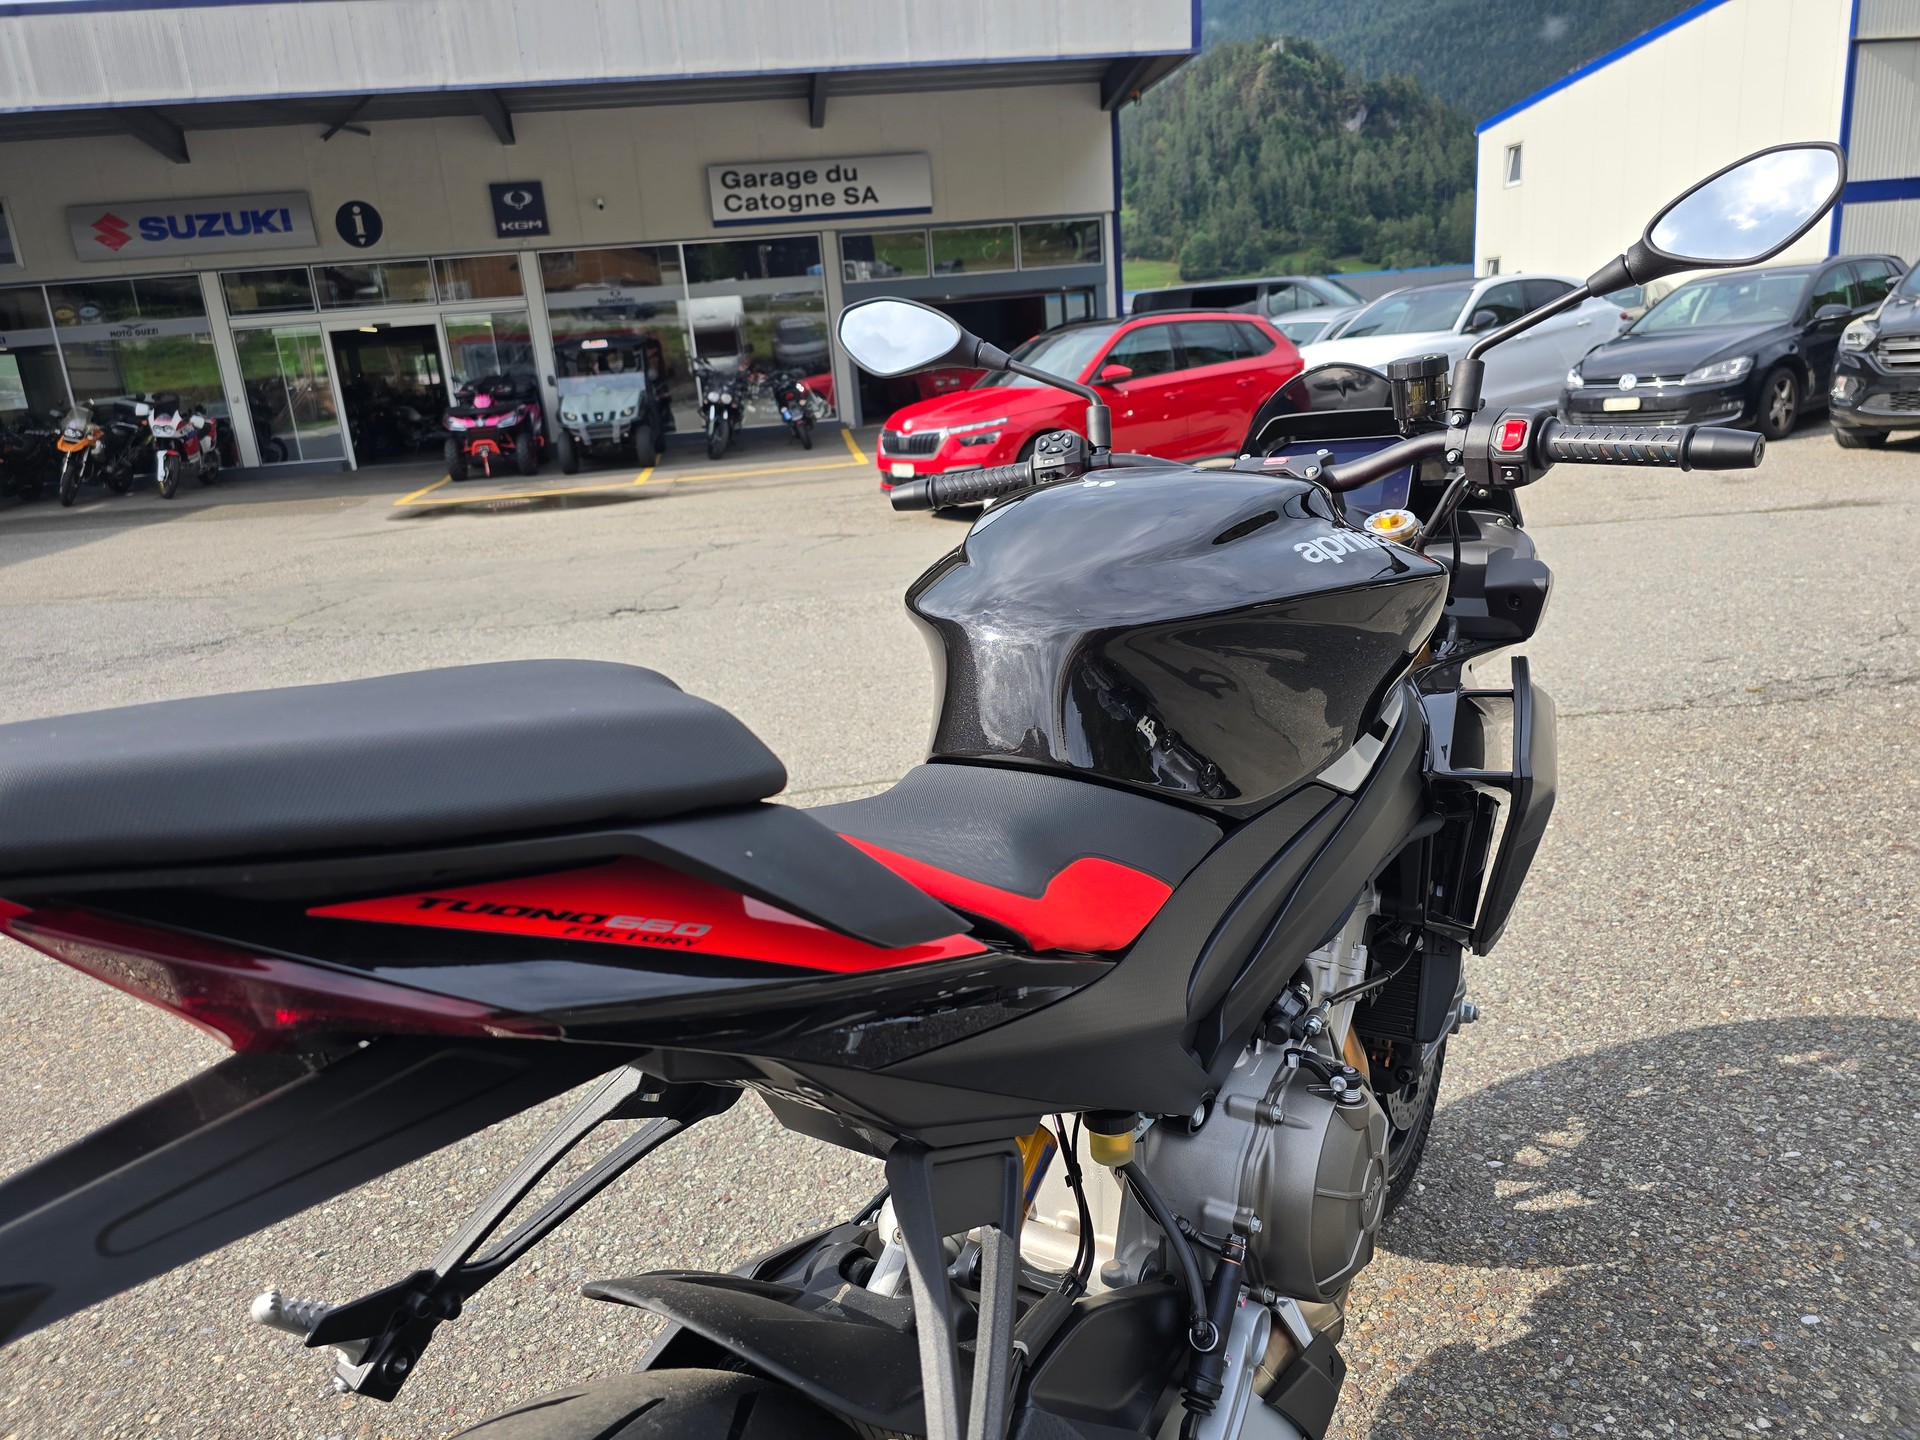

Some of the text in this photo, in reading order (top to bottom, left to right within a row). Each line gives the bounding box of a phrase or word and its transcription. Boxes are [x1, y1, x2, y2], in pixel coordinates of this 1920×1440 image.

[721, 165, 858, 189] Garage du
[724, 186, 879, 213] Catogne SA
[138, 208, 293, 241] SUZUKI
[501, 220, 543, 231] KGM
[109, 328, 159, 338] MOTO GUZZI
[563, 927, 700, 947] FACTORY
